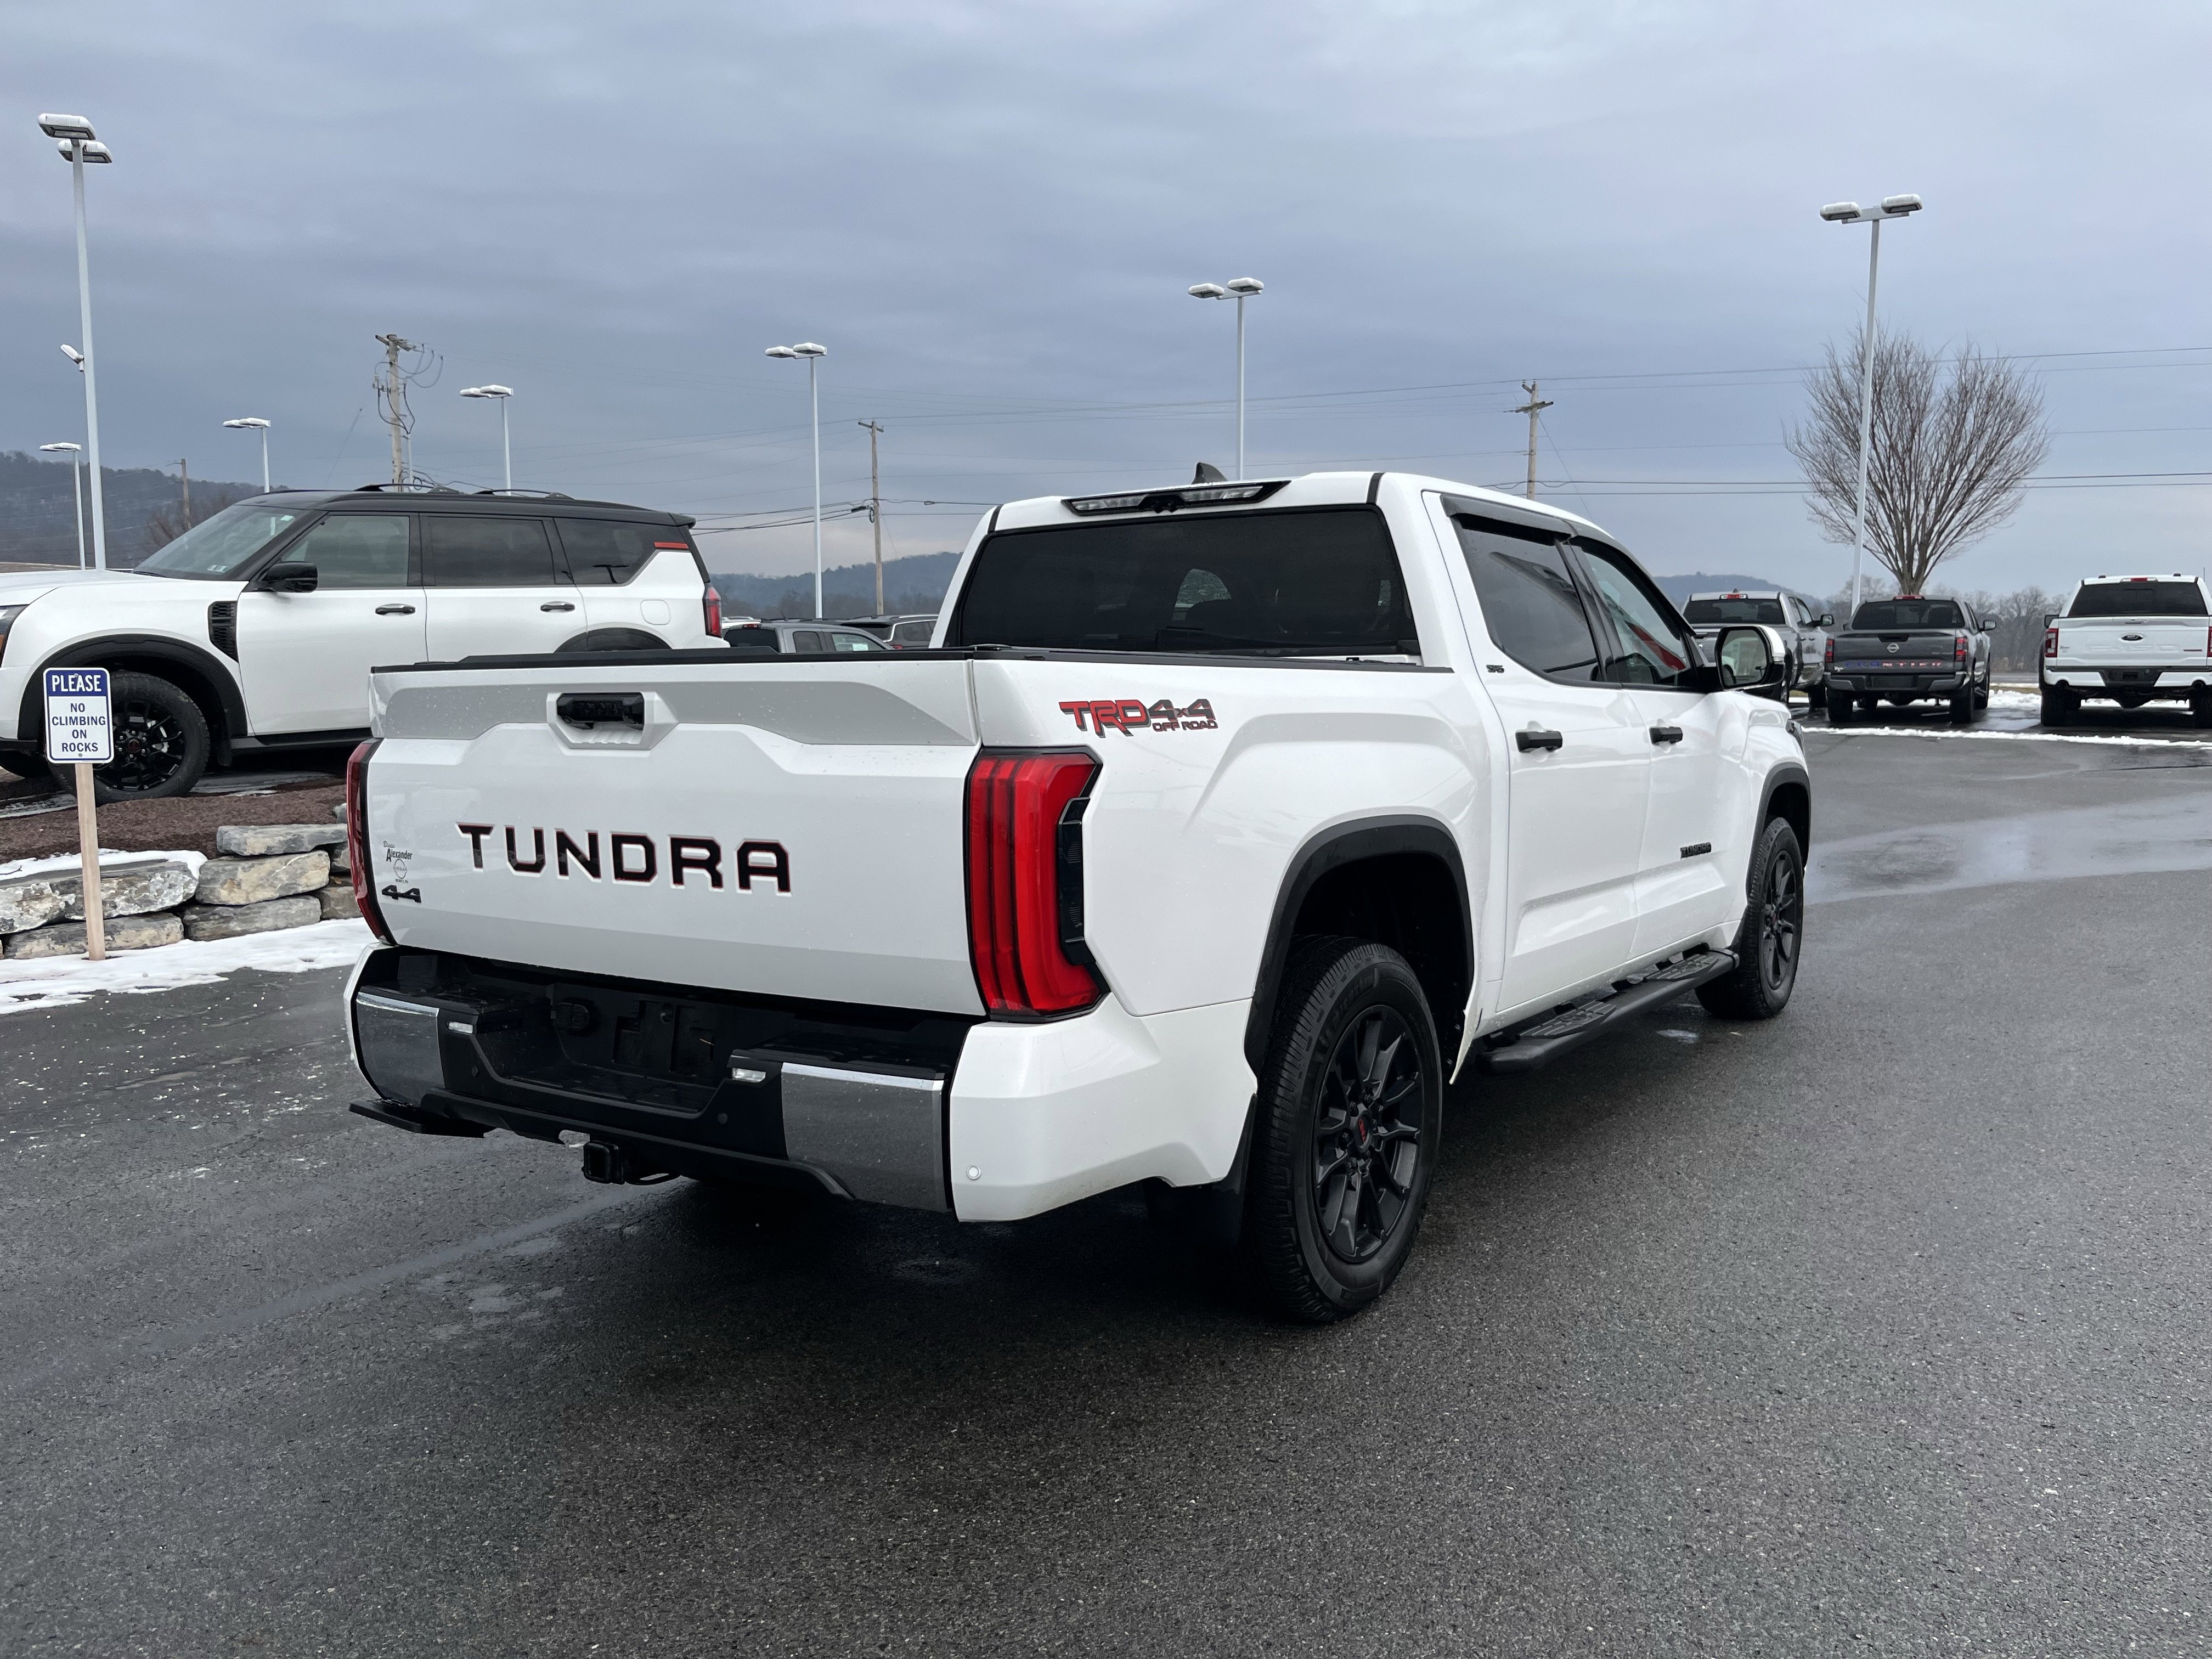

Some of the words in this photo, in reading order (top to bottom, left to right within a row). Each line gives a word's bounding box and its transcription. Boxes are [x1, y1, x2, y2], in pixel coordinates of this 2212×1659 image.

[52, 675, 102, 692] PLEASE
[70, 703, 85, 713] NO
[52, 716, 106, 725] CLIMBING
[1058, 699, 1151, 738] TRD
[1152, 722, 1180, 732] OFF
[1181, 720, 1218, 730] ROAD
[72, 729, 87, 738] ON
[61, 742, 98, 752] ROCKS
[386, 848, 413, 862] Alexander
[456, 823, 792, 894] TUNDRA
